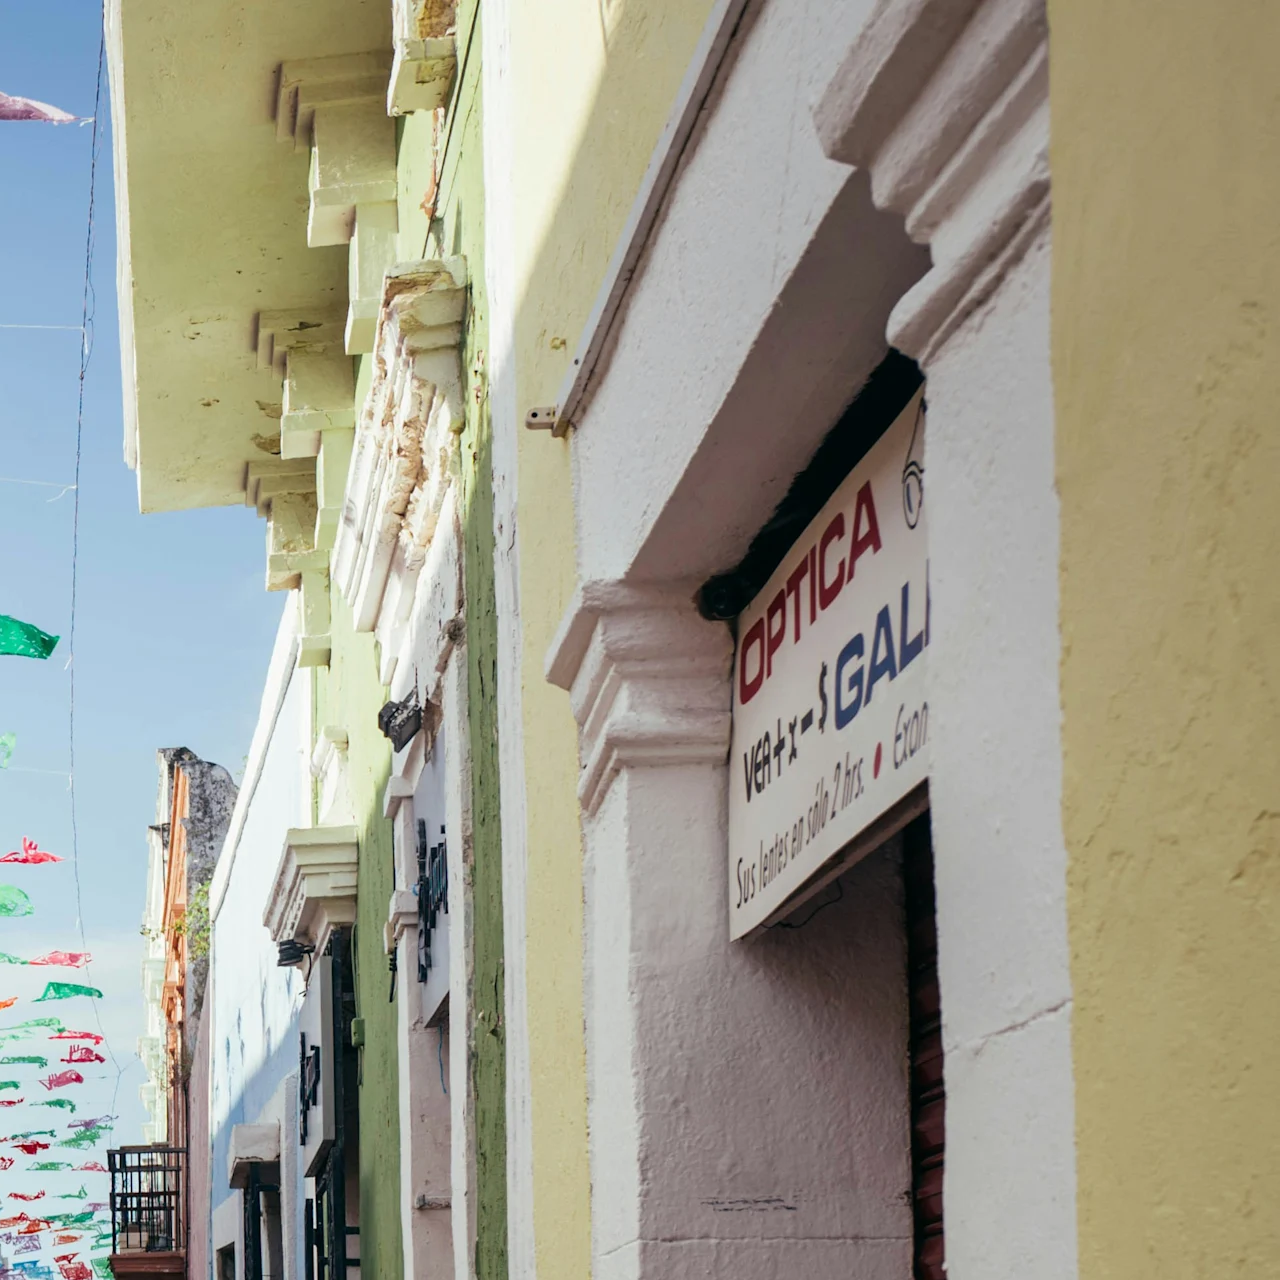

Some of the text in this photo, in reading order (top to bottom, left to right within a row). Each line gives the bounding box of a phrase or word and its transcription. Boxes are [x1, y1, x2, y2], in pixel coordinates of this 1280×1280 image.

[740, 479, 882, 706] OPTICA
[835, 558, 931, 731] GAL
[736, 857, 755, 909] Sus
[759, 832, 788, 892] lentes
[791, 816, 803, 860] en
[830, 761, 841, 821] 2
